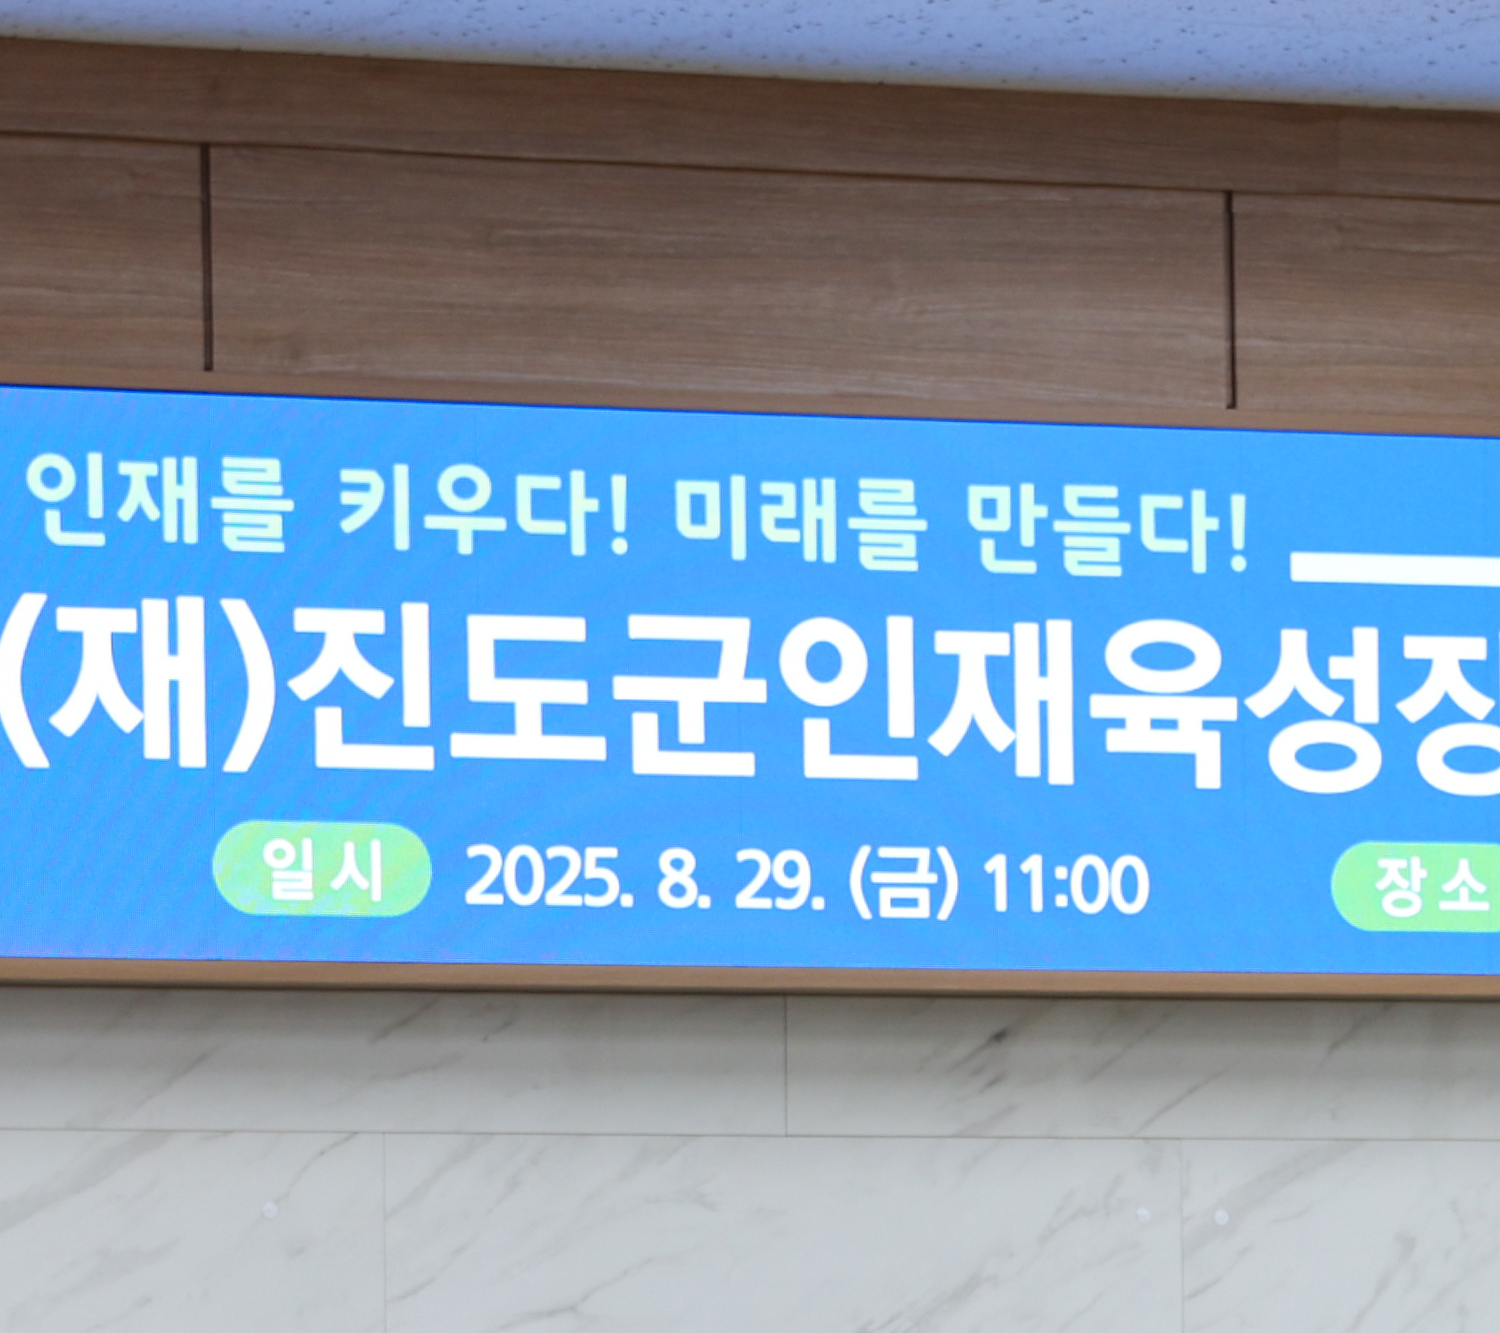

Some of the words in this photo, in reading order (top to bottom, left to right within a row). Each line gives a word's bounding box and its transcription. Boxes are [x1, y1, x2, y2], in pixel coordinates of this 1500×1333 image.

[27, 453, 294, 552] 인재를
[341, 464, 628, 555] 키우다!
[676, 475, 927, 571] 미래를
[969, 484, 1247, 576] 만들다!
[263, 838, 382, 902] 일시
[464, 844, 633, 908] 2025.
[657, 846, 711, 909] 8.
[735, 849, 826, 911] 29.
[849, 845, 959, 921] (금)
[984, 853, 1150, 915] 11:00
[1375, 856, 1490, 918] 장소
